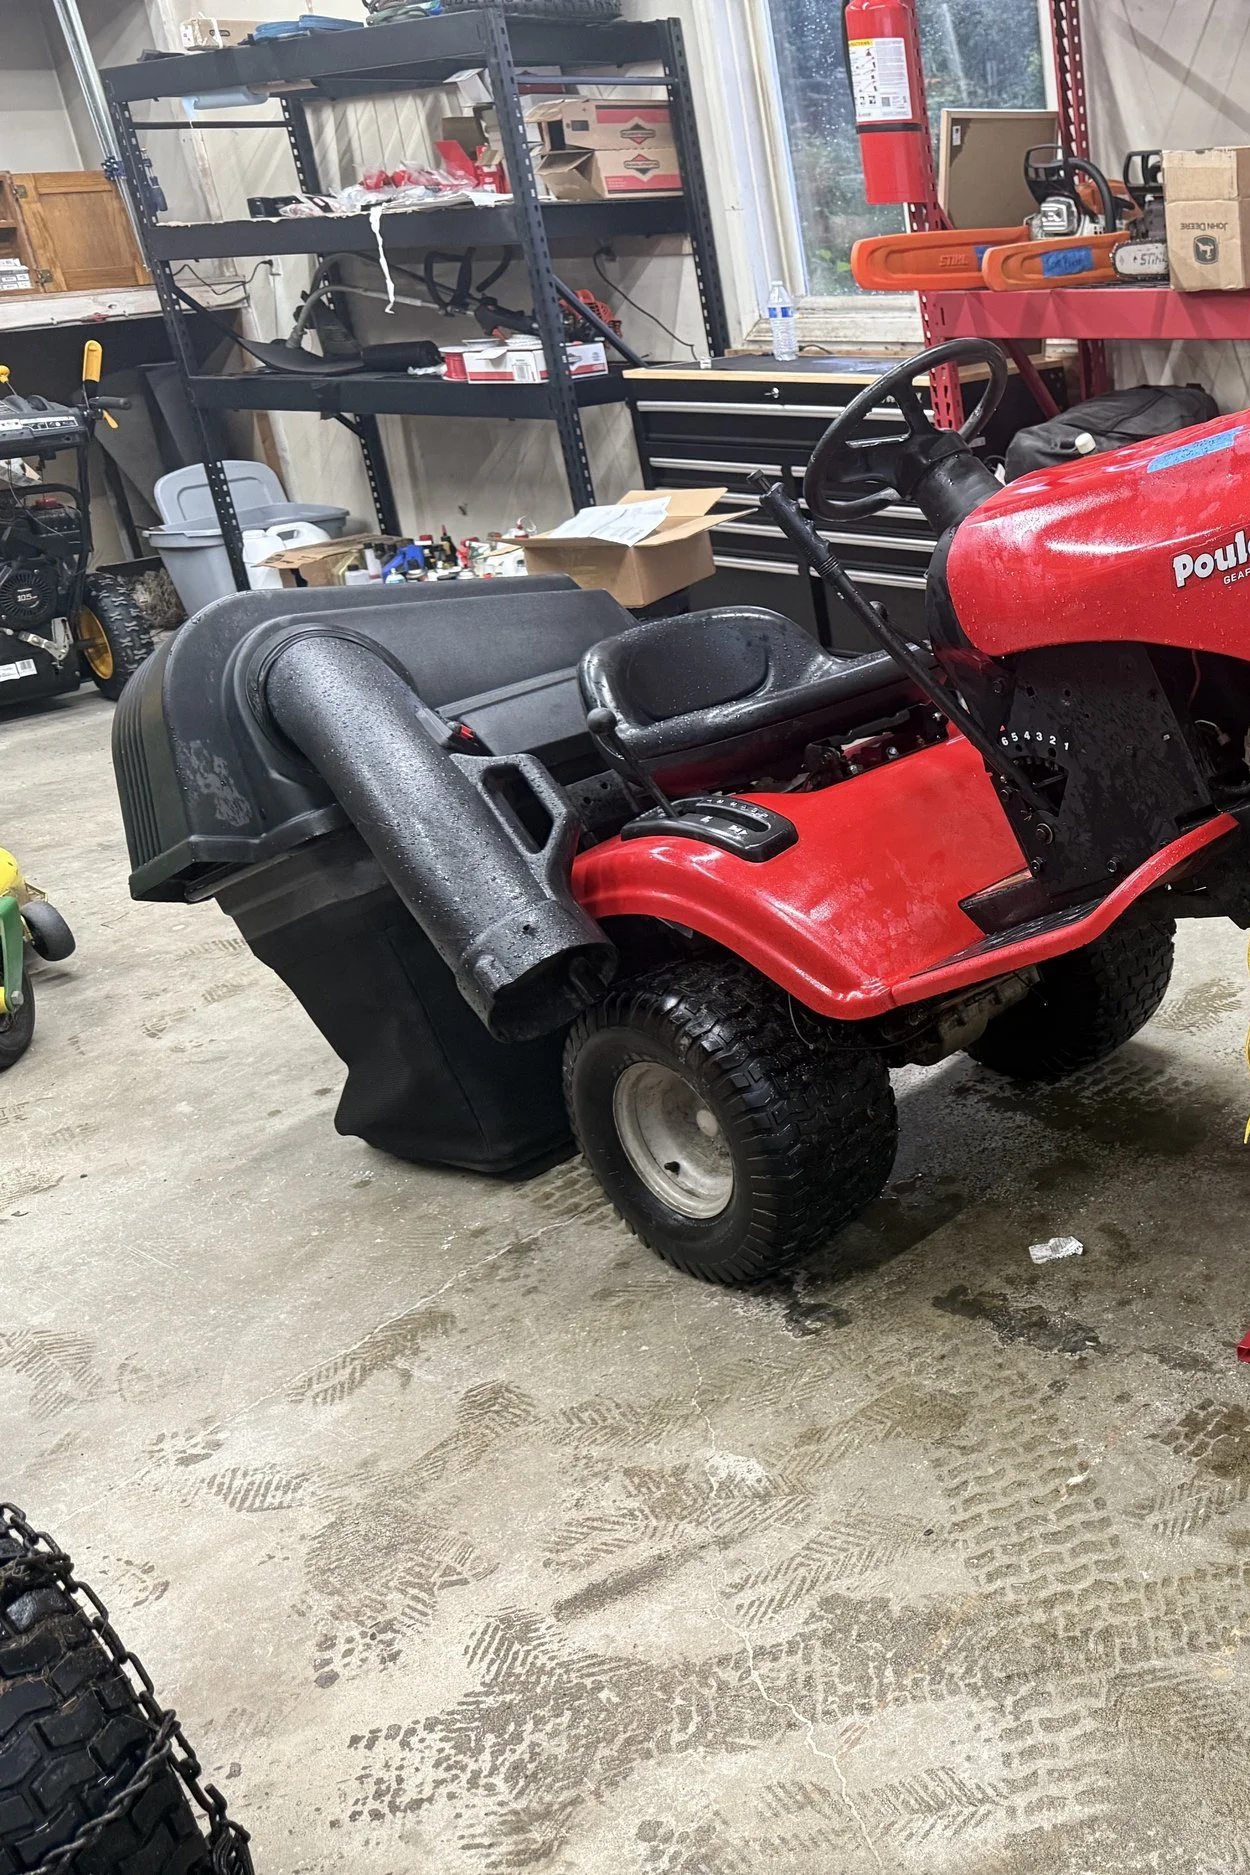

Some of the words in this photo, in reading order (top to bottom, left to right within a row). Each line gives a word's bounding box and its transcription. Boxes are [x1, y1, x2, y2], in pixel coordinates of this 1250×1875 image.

[1180, 222, 1206, 231] DEERE
[1207, 222, 1229, 231] JOHN
[1001, 736, 1009, 746] 6
[1011, 732, 1018, 741] 5
[1024, 731, 1031, 740] 4
[1036, 732, 1043, 741] 3
[1049, 735, 1056, 745] 2
[1064, 742, 1069, 751] 1
